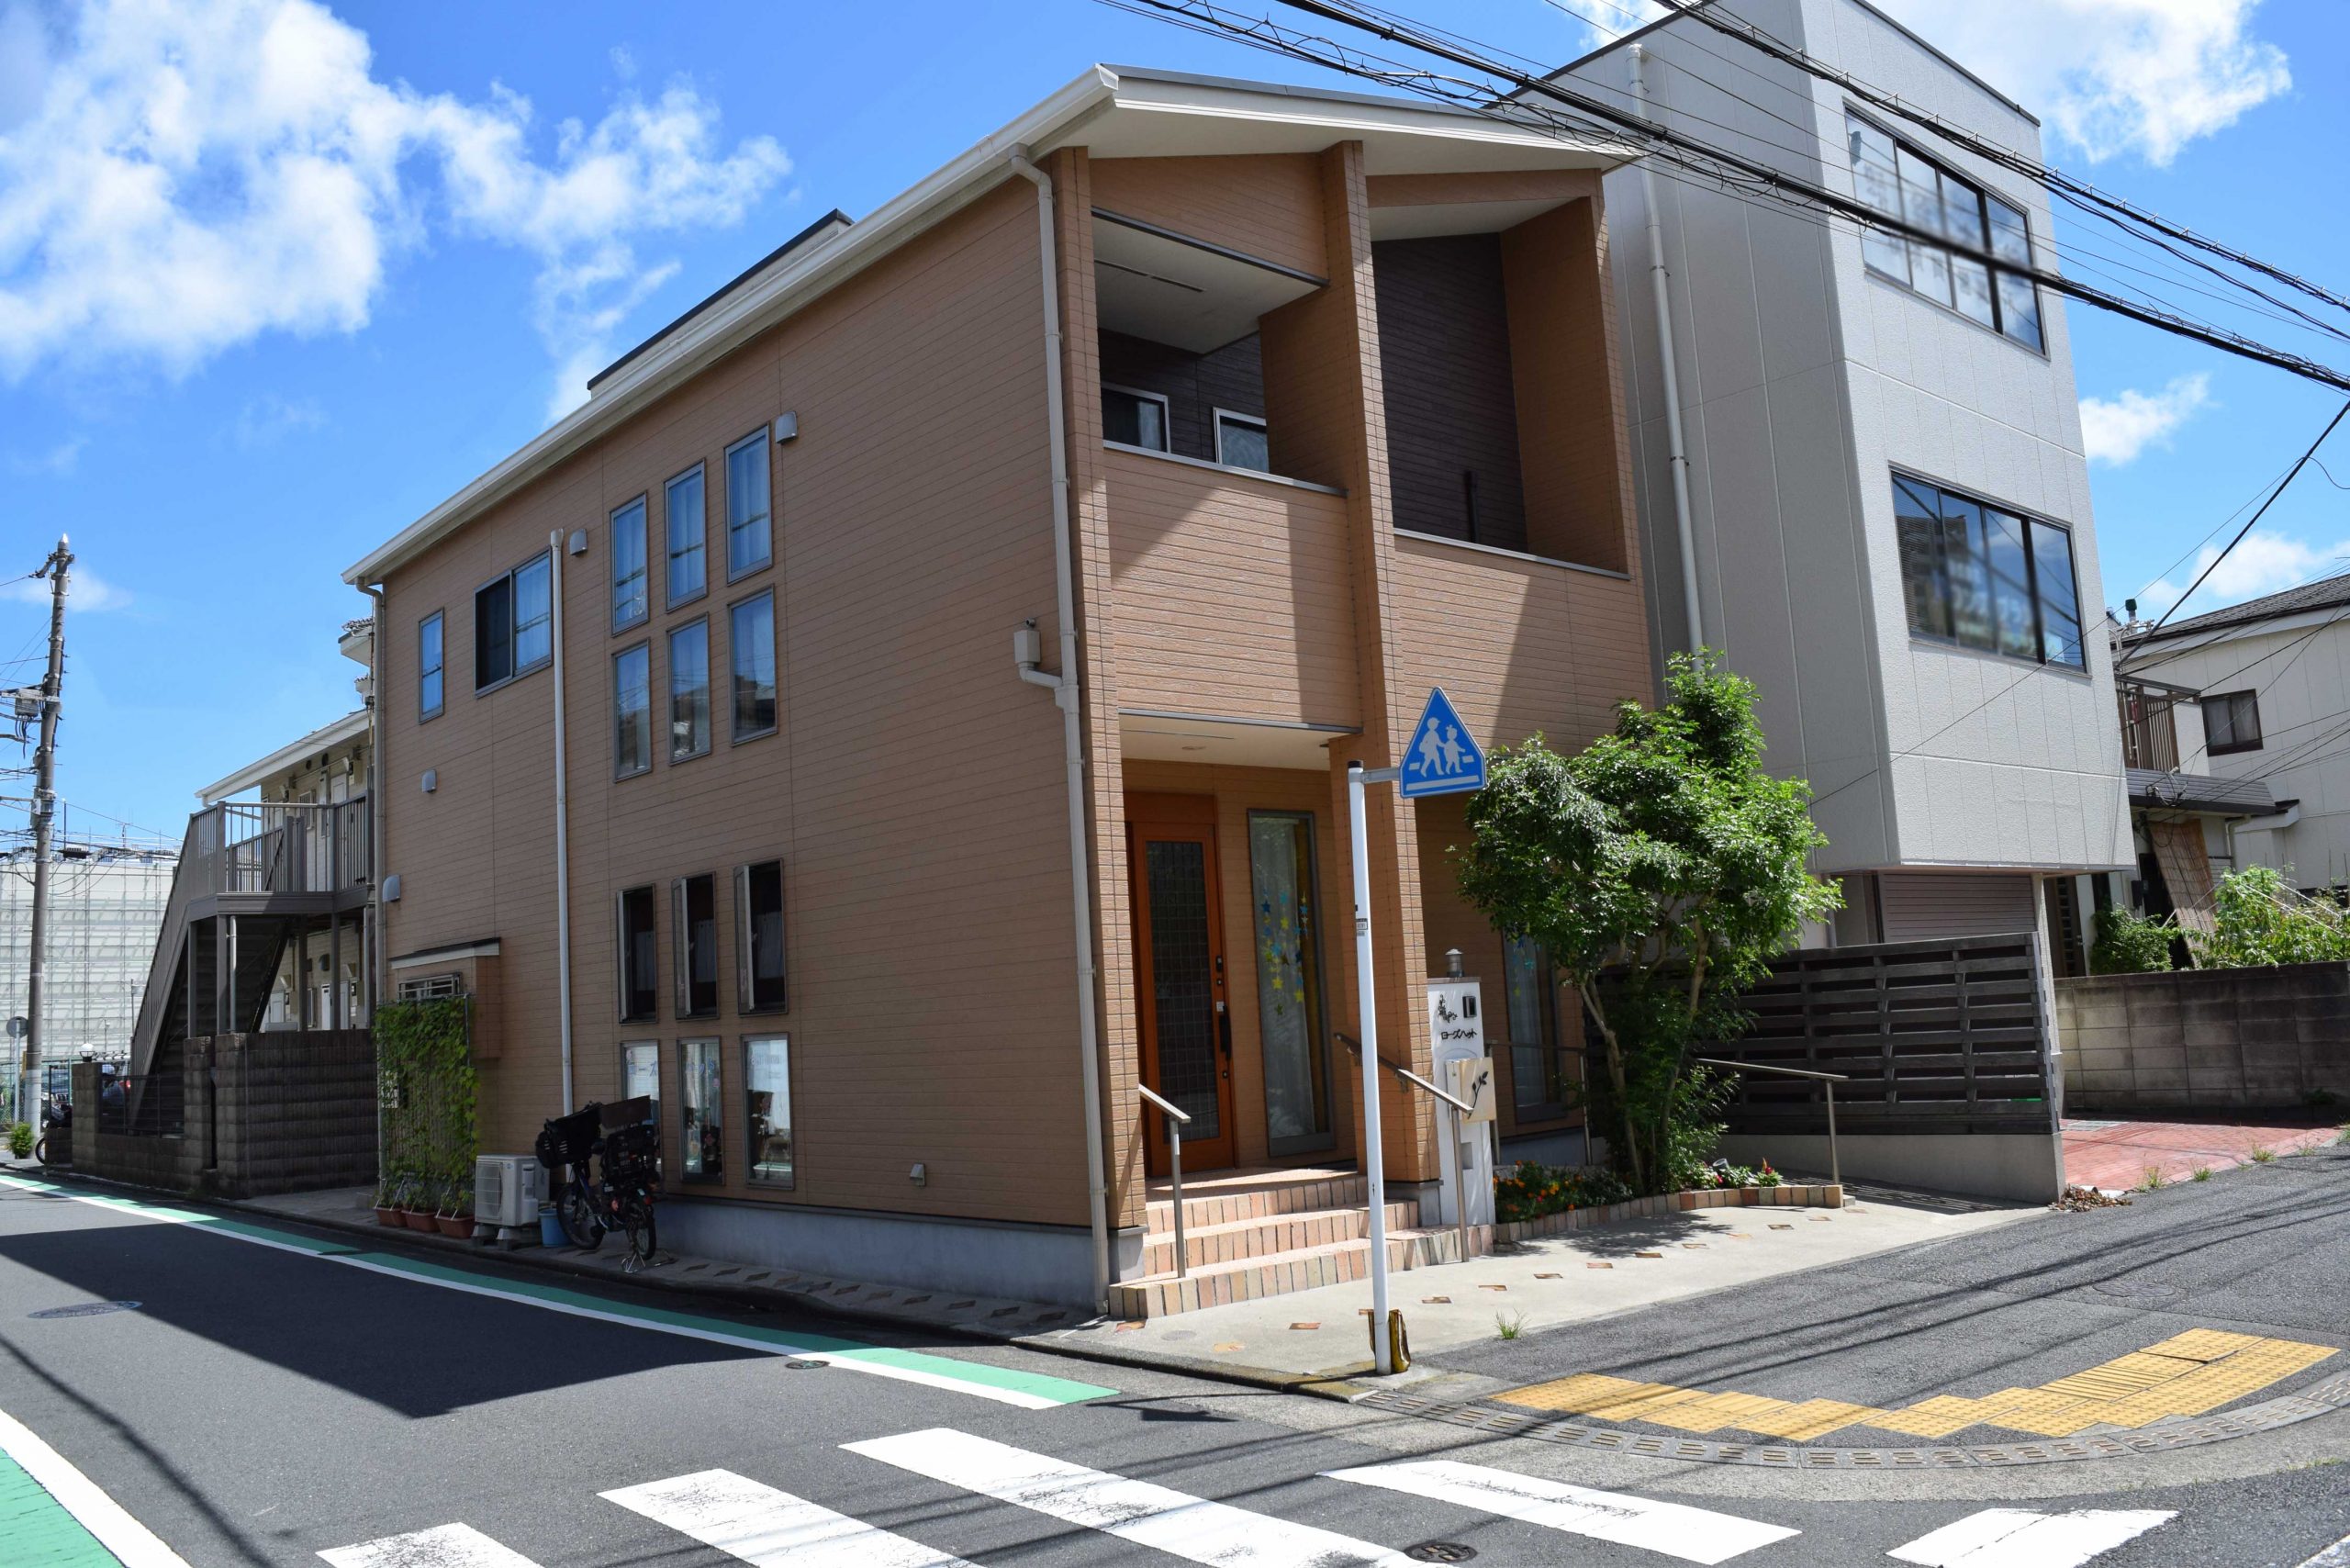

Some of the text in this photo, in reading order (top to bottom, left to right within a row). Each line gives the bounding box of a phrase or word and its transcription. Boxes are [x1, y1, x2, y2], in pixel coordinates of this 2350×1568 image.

[1440, 1027, 1477, 1040] ローズハット
